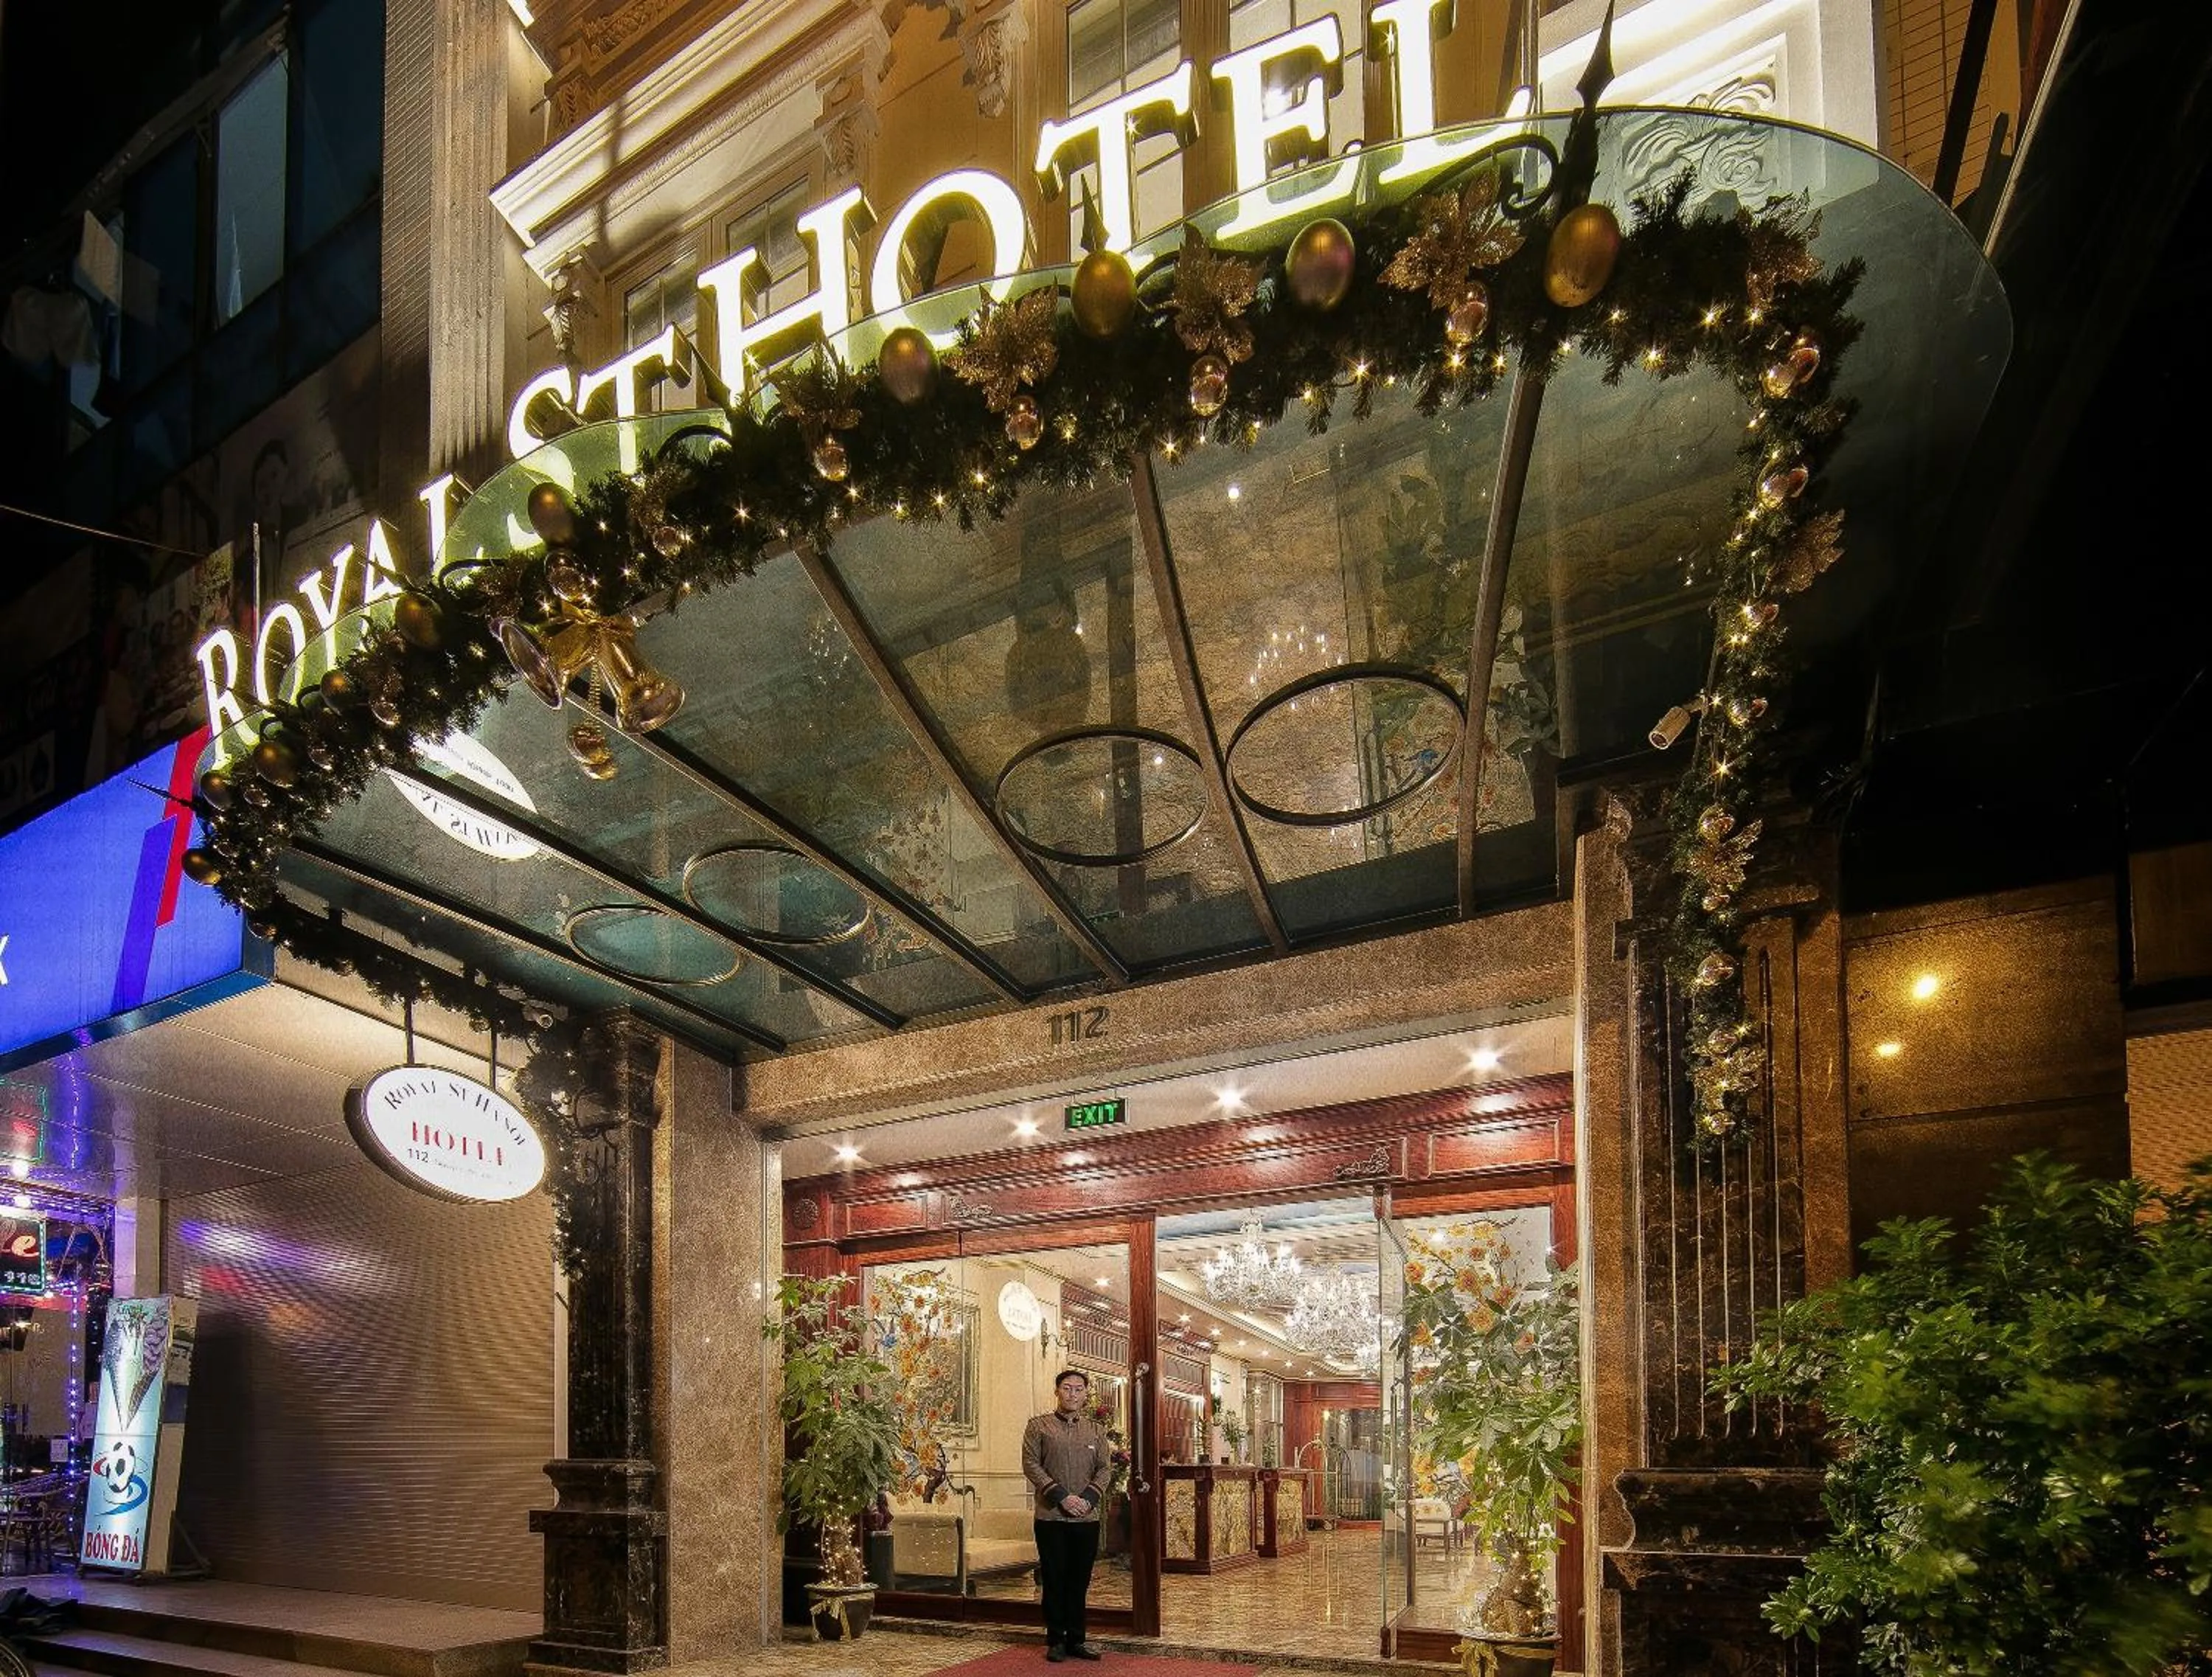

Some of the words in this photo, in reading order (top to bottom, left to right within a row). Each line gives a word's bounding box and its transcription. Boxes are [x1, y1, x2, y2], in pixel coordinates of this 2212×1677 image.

[196, 472, 484, 770] ROYAL
[508, 366, 674, 550] ST
[697, 0, 1533, 450] HOTEL
[1048, 1006, 1110, 1044] 112
[1071, 1103, 1118, 1126] EXIT
[408, 1148, 429, 1163] 112
[86, 1524, 119, 1561] BÓNG
